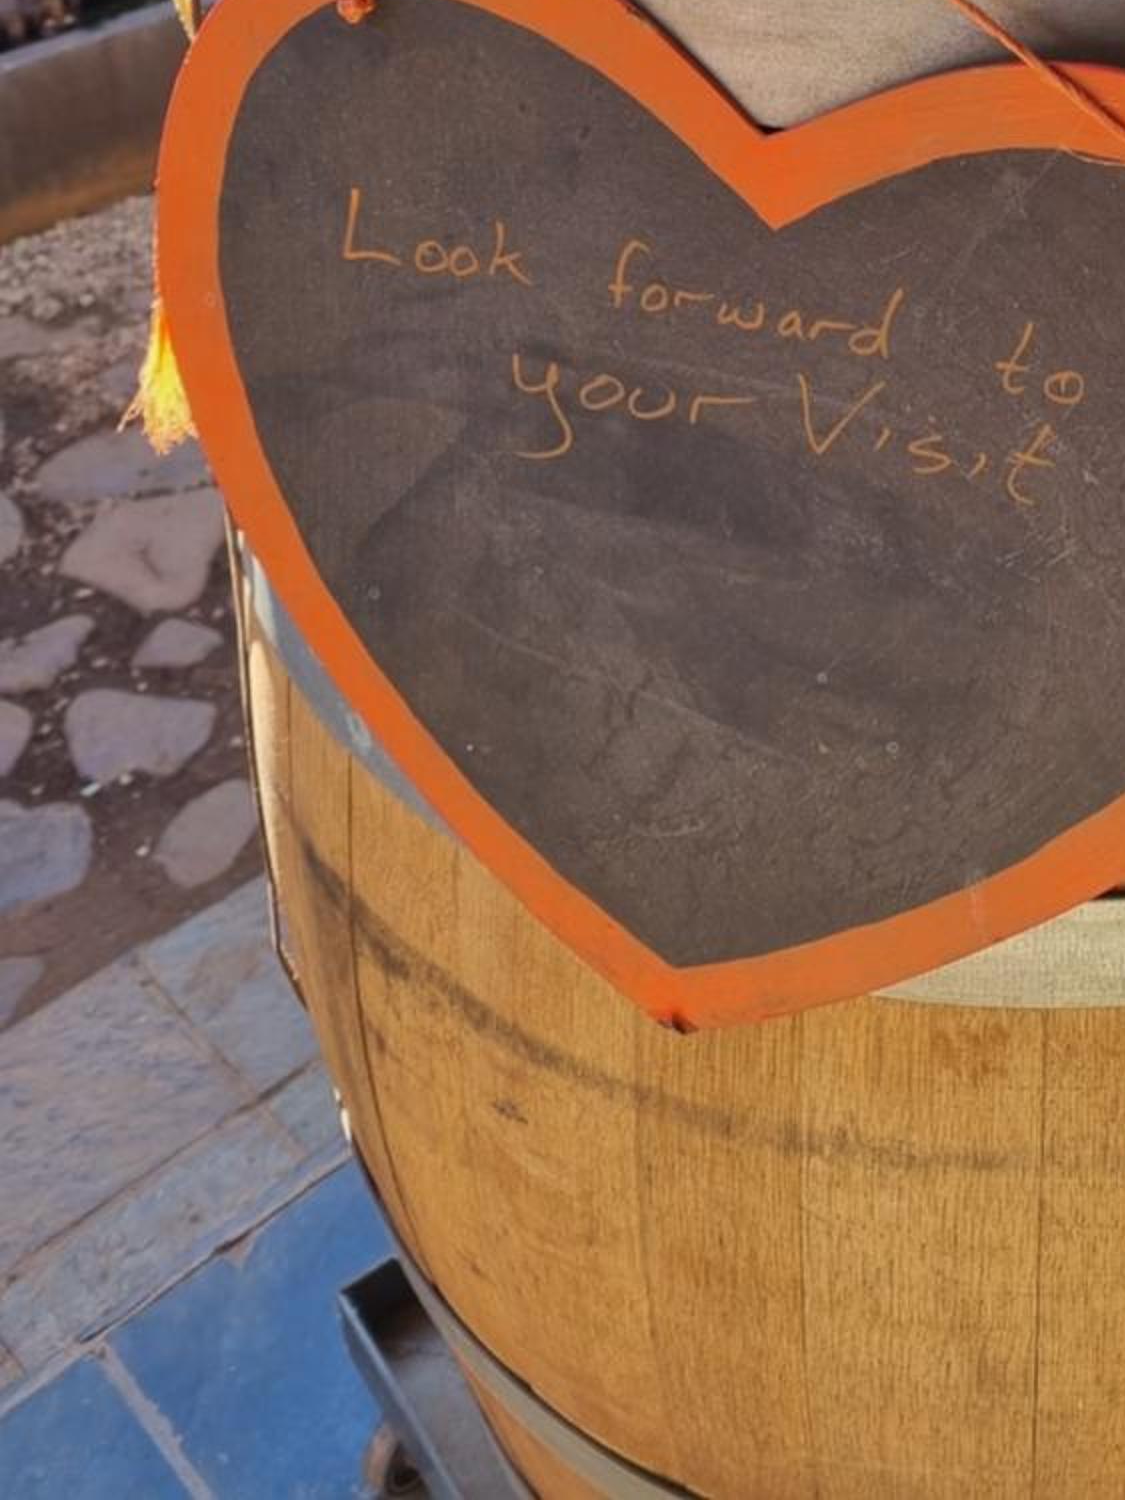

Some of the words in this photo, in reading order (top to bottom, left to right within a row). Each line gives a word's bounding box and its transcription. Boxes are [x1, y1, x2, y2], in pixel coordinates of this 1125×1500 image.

[340, 186, 535, 286] Look
[606, 238, 905, 360] forward
[993, 321, 1087, 406] to
[510, 351, 756, 461] your
